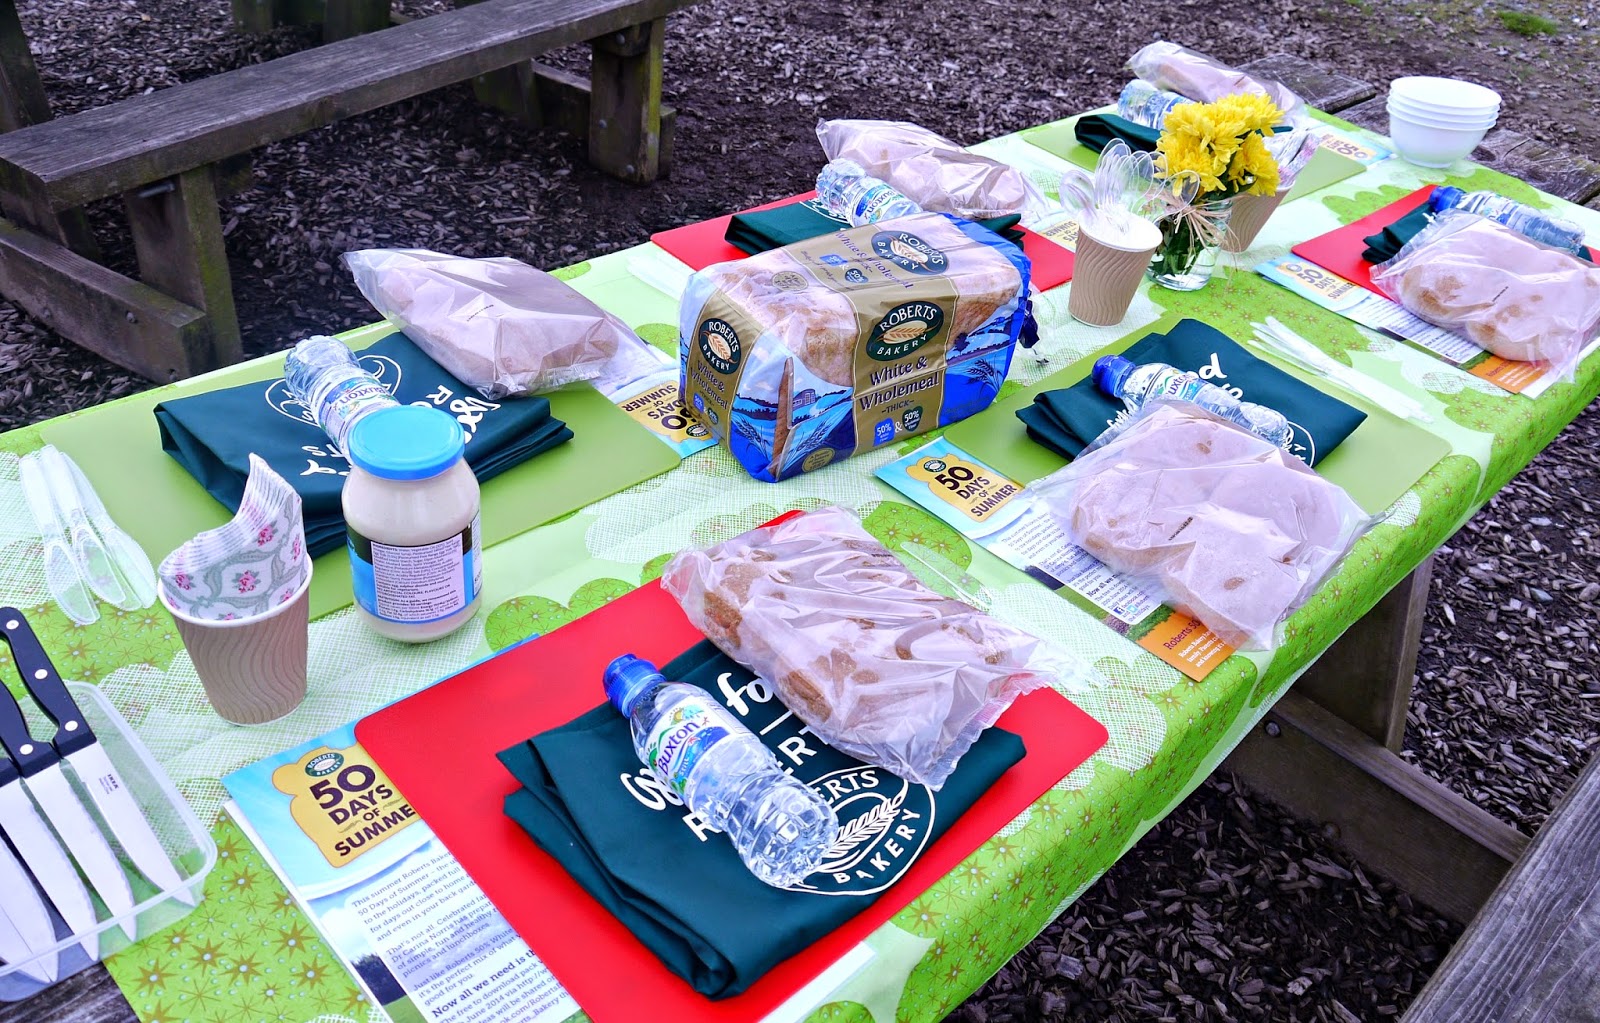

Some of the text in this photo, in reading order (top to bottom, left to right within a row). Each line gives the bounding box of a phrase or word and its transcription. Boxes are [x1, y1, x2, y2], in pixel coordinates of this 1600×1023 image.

[899, 233, 944, 265] ROBERTS
[1297, 268, 1324, 284] 50
[880, 304, 938, 332] ROBERTS
[708, 321, 740, 352] ROBERTS
[877, 334, 927, 356] BAKERY
[698, 360, 718, 386] White
[702, 344, 730, 371] BAKERY
[870, 356, 928, 386] White &
[340, 387, 386, 404] Buxton
[621, 384, 678, 412] SUMMER
[690, 367, 728, 410] Wholemeal
[860, 372, 940, 412] Wholemeal
[647, 400, 684, 420] DAYS
[904, 410, 920, 424] 50%
[876, 422, 892, 437] 50%
[894, 422, 902, 433] &
[934, 466, 974, 491] 50
[956, 476, 990, 500] DAYS
[978, 490, 988, 498] OF
[970, 484, 1018, 517] SUMMER
[1163, 628, 1192, 650] Roberts
[308, 752, 336, 769] ROBERTS
[658, 721, 700, 776] Buxton
[108, 774, 119, 789] IKEA
[316, 761, 342, 776] BAKERY
[309, 764, 376, 810] 50
[328, 784, 393, 826] DAYS
[362, 808, 380, 821] OF
[833, 808, 920, 884] BAKERY
[352, 896, 370, 908] This
[371, 878, 402, 898] summer
[402, 862, 430, 880] Roberts
[364, 916, 374, 925] to
[374, 908, 386, 919] the
[388, 890, 422, 912] holidays,
[422, 874, 448, 892] packed
[369, 898, 388, 911] Days
[389, 891, 398, 900] of
[398, 872, 429, 894] Summer
[436, 862, 449, 872] the
[370, 875, 465, 934] for days out close to home
[376, 931, 392, 942] and
[392, 919, 412, 932] even
[412, 913, 422, 921] in
[421, 902, 440, 918] your
[438, 891, 458, 904] back
[386, 940, 410, 956] That's
[411, 931, 424, 942] not
[436, 900, 476, 926] Celebrated
[392, 954, 402, 963] Dr
[402, 940, 429, 956] Carina
[430, 923, 454, 940] Norris
[455, 915, 468, 926] has
[398, 961, 407, 970] of
[434, 936, 450, 948] fun
[450, 926, 464, 939] and
[465, 910, 492, 930] healthy
[402, 958, 432, 978] picnics
[432, 948, 446, 960] and
[413, 928, 514, 992] Just like Roberts 50% White
[418, 936, 516, 999] it's the perfect mix of what
[424, 990, 445, 1007] good
[445, 982, 457, 994] for
[432, 998, 458, 1018] Now
[460, 988, 473, 1001] all
[473, 979, 490, 992] we
[490, 962, 516, 982] need
[515, 956, 526, 965] is
[456, 1004, 473, 1016] free
[473, 998, 482, 1006] to
[482, 974, 520, 1000] download
[520, 962, 538, 977] pack
[495, 980, 546, 1016] will be shared
[466, 1008, 486, 1022] June
[486, 994, 504, 1010] 2014
[504, 988, 518, 997] via
